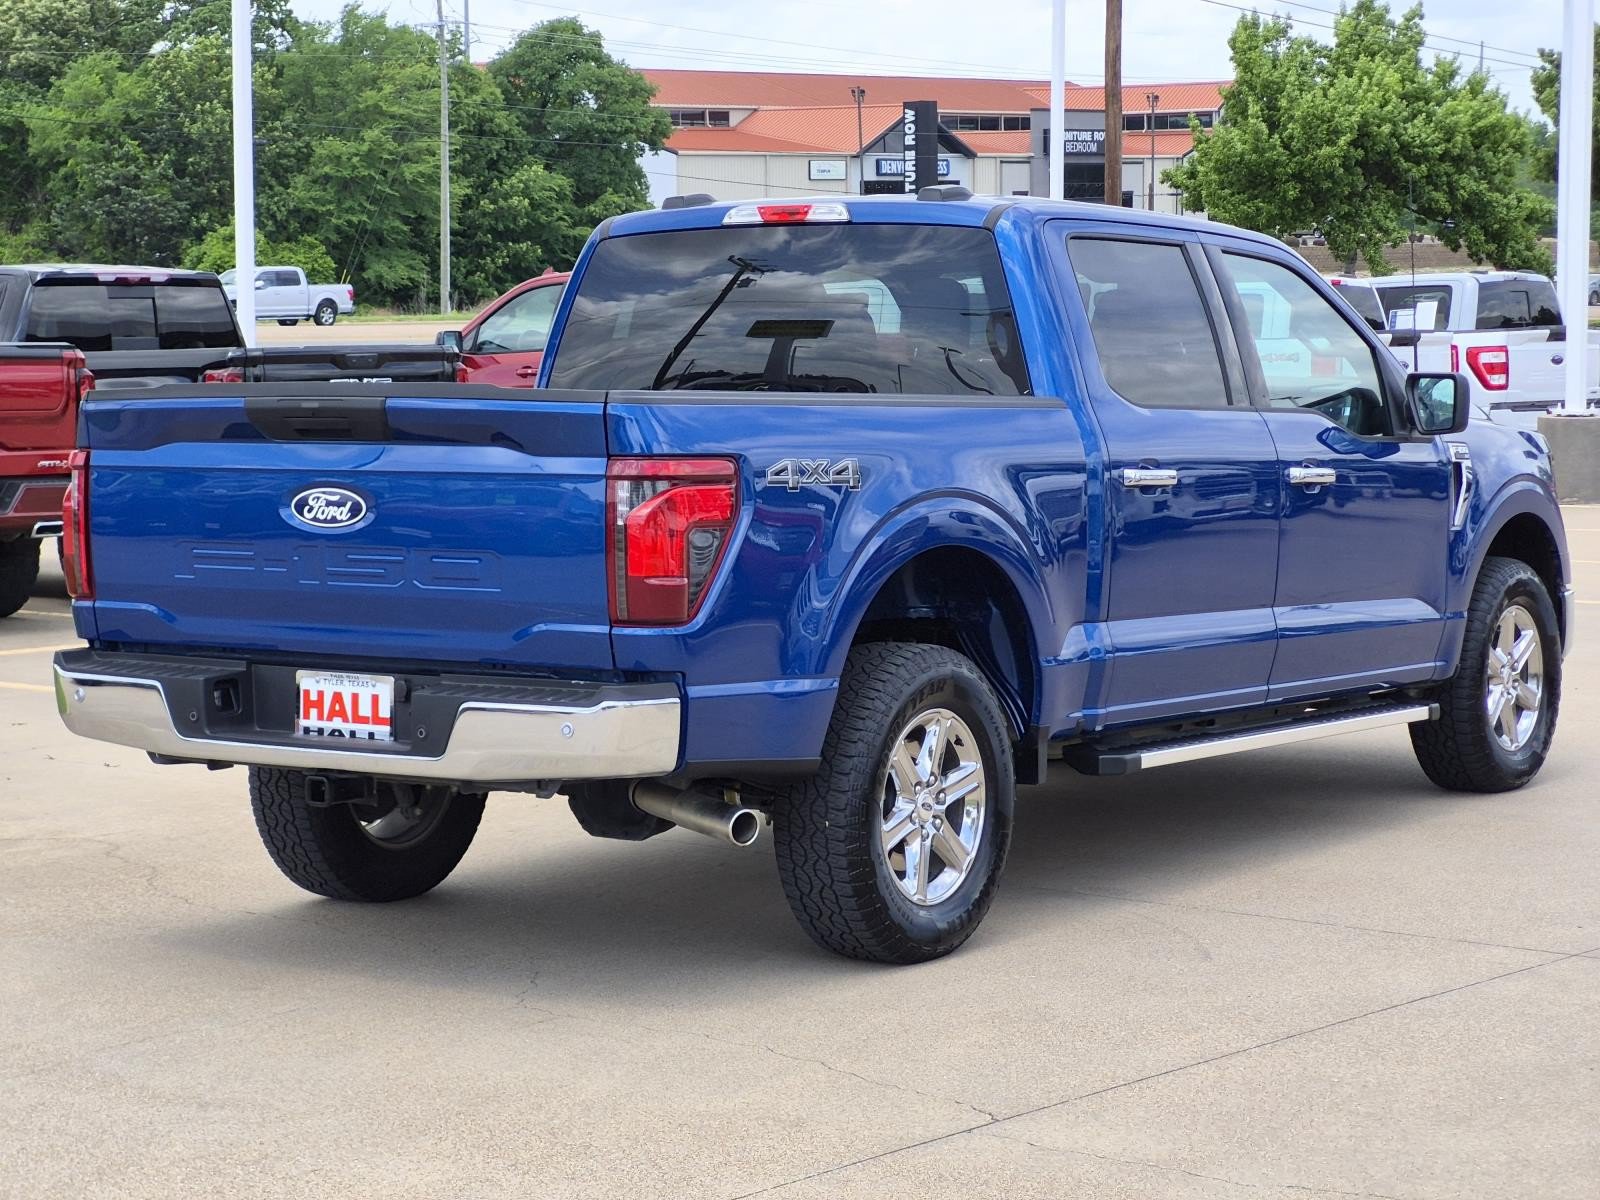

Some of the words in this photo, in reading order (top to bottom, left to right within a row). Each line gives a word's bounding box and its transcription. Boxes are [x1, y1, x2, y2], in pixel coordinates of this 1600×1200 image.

[905, 108, 915, 145] ROW
[1064, 131, 1091, 141] NITURE
[1094, 131, 1105, 141] RO
[1065, 142, 1097, 152] BEDROOM
[881, 160, 904, 173] DENV
[303, 492, 352, 521] Ford
[173, 540, 502, 591] F-150
[348, 680, 370, 688] TEXAS
[302, 689, 391, 726] HALL
